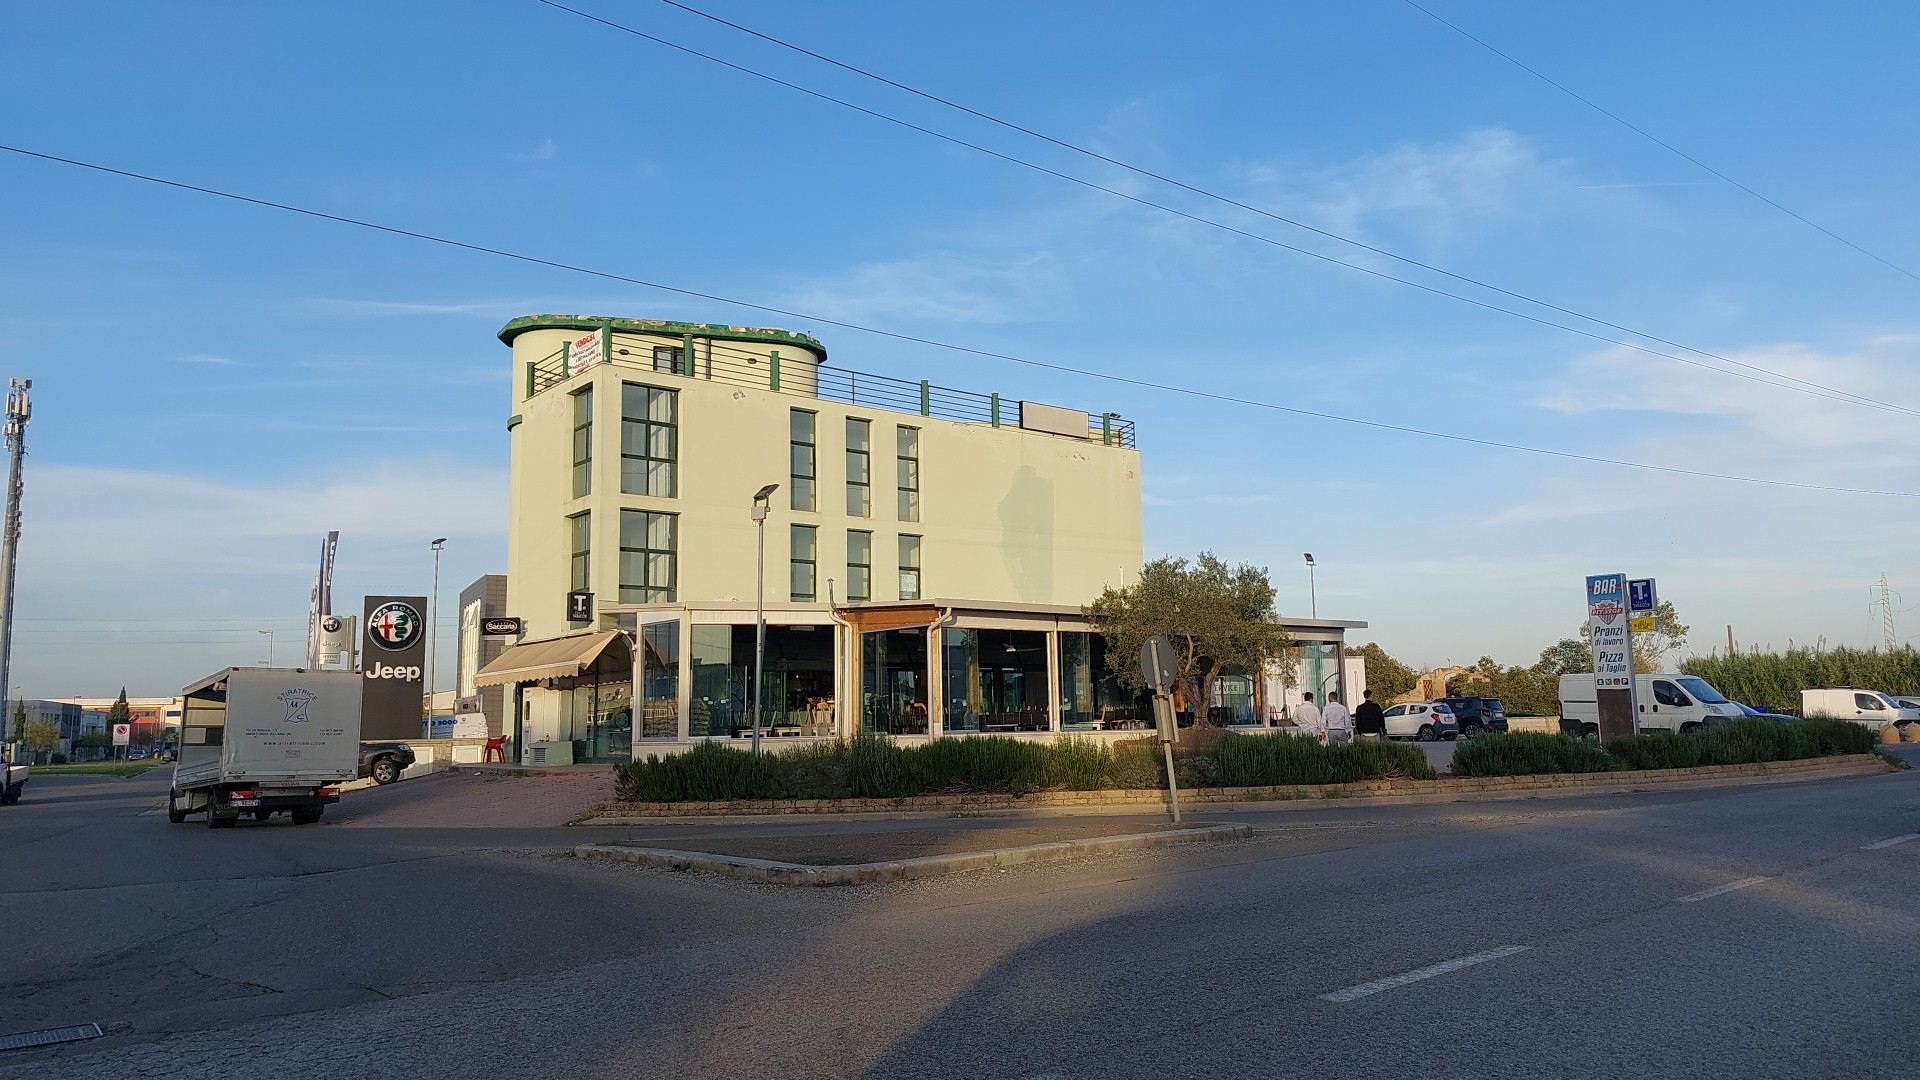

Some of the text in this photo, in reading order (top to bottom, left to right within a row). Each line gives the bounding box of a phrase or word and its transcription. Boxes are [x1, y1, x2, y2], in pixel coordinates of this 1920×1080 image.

[1594, 578, 1616, 595] BAR
[1632, 582, 1646, 600] T
[574, 595, 587, 612] T
[371, 605, 419, 628] ALFA ROMEO
[1594, 625, 1624, 637] Pranzi
[1594, 638, 1624, 646] di lavoro
[1599, 652, 1624, 662] Pizza
[366, 662, 420, 682] Jeep
[1598, 663, 1626, 674] al Taglio
[276, 688, 318, 702] STIRATRICE
